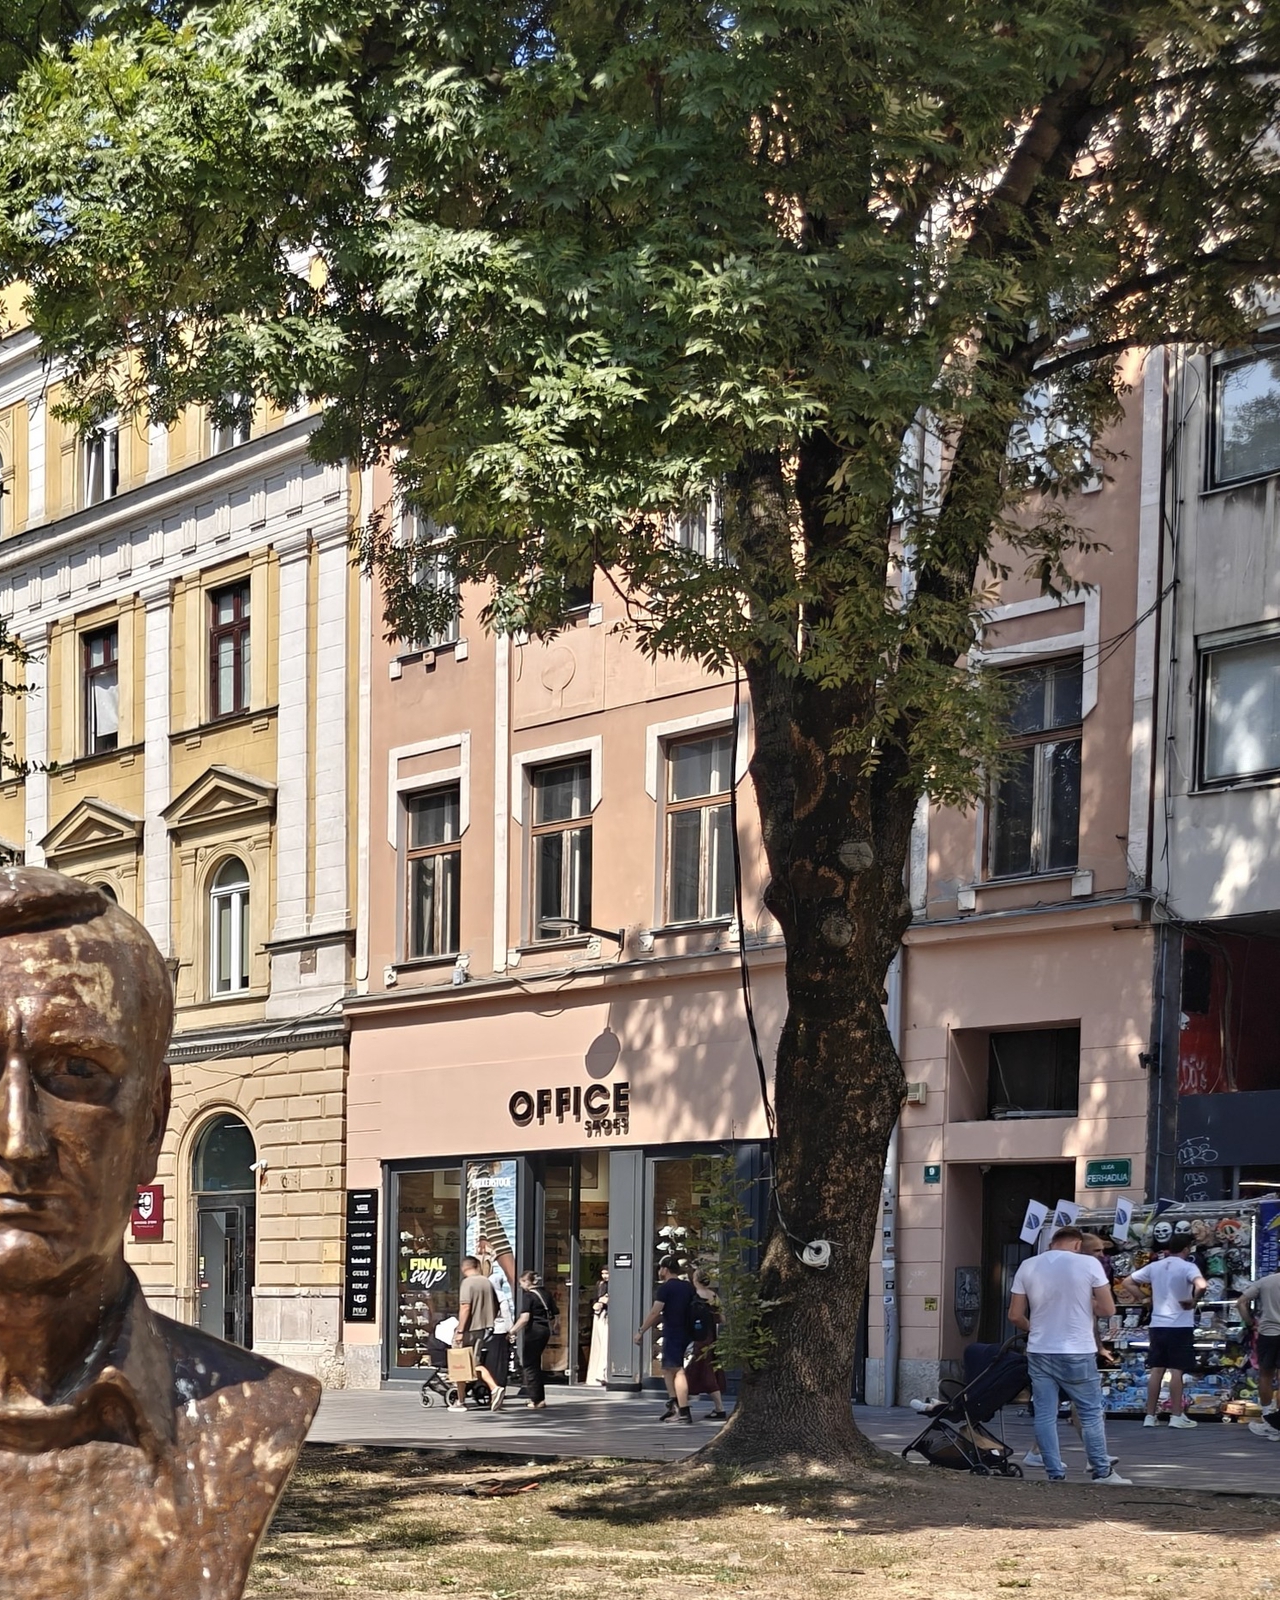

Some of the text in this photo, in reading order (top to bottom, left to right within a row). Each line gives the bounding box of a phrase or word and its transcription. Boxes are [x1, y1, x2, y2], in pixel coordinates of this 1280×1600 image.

[509, 1082, 629, 1123] OFFICE
[929, 1167, 935, 1176] 9
[1086, 1173, 1129, 1183] FERHADIJA
[410, 1256, 447, 1271] FINAL
[410, 1269, 447, 1289] sale
[353, 1294, 367, 1304] UGG
